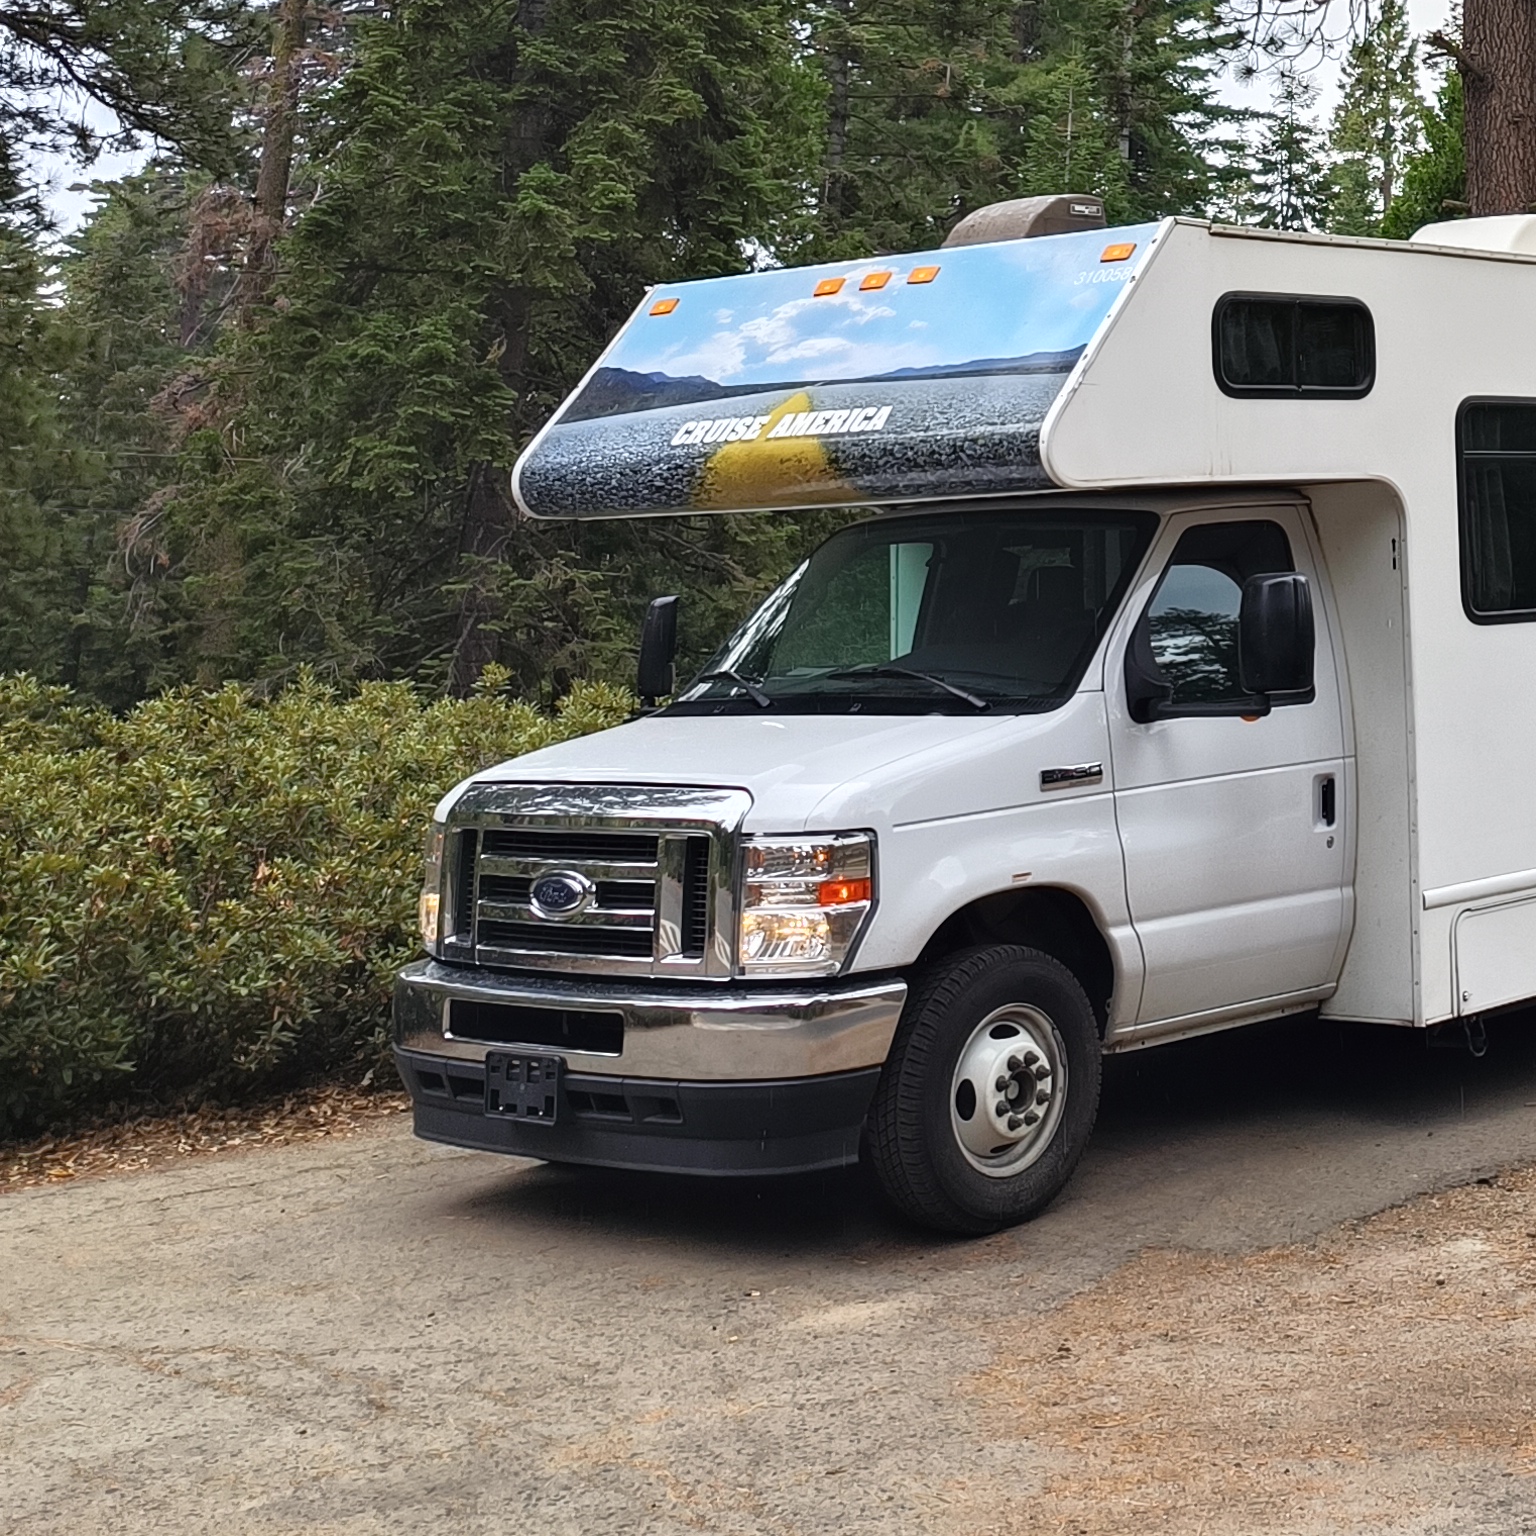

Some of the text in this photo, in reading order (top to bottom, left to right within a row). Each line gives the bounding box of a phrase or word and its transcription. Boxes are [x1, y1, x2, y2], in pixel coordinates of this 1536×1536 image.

[1073, 266, 1134, 286] 310058
[670, 405, 893, 446] CRUISE AMERICA
